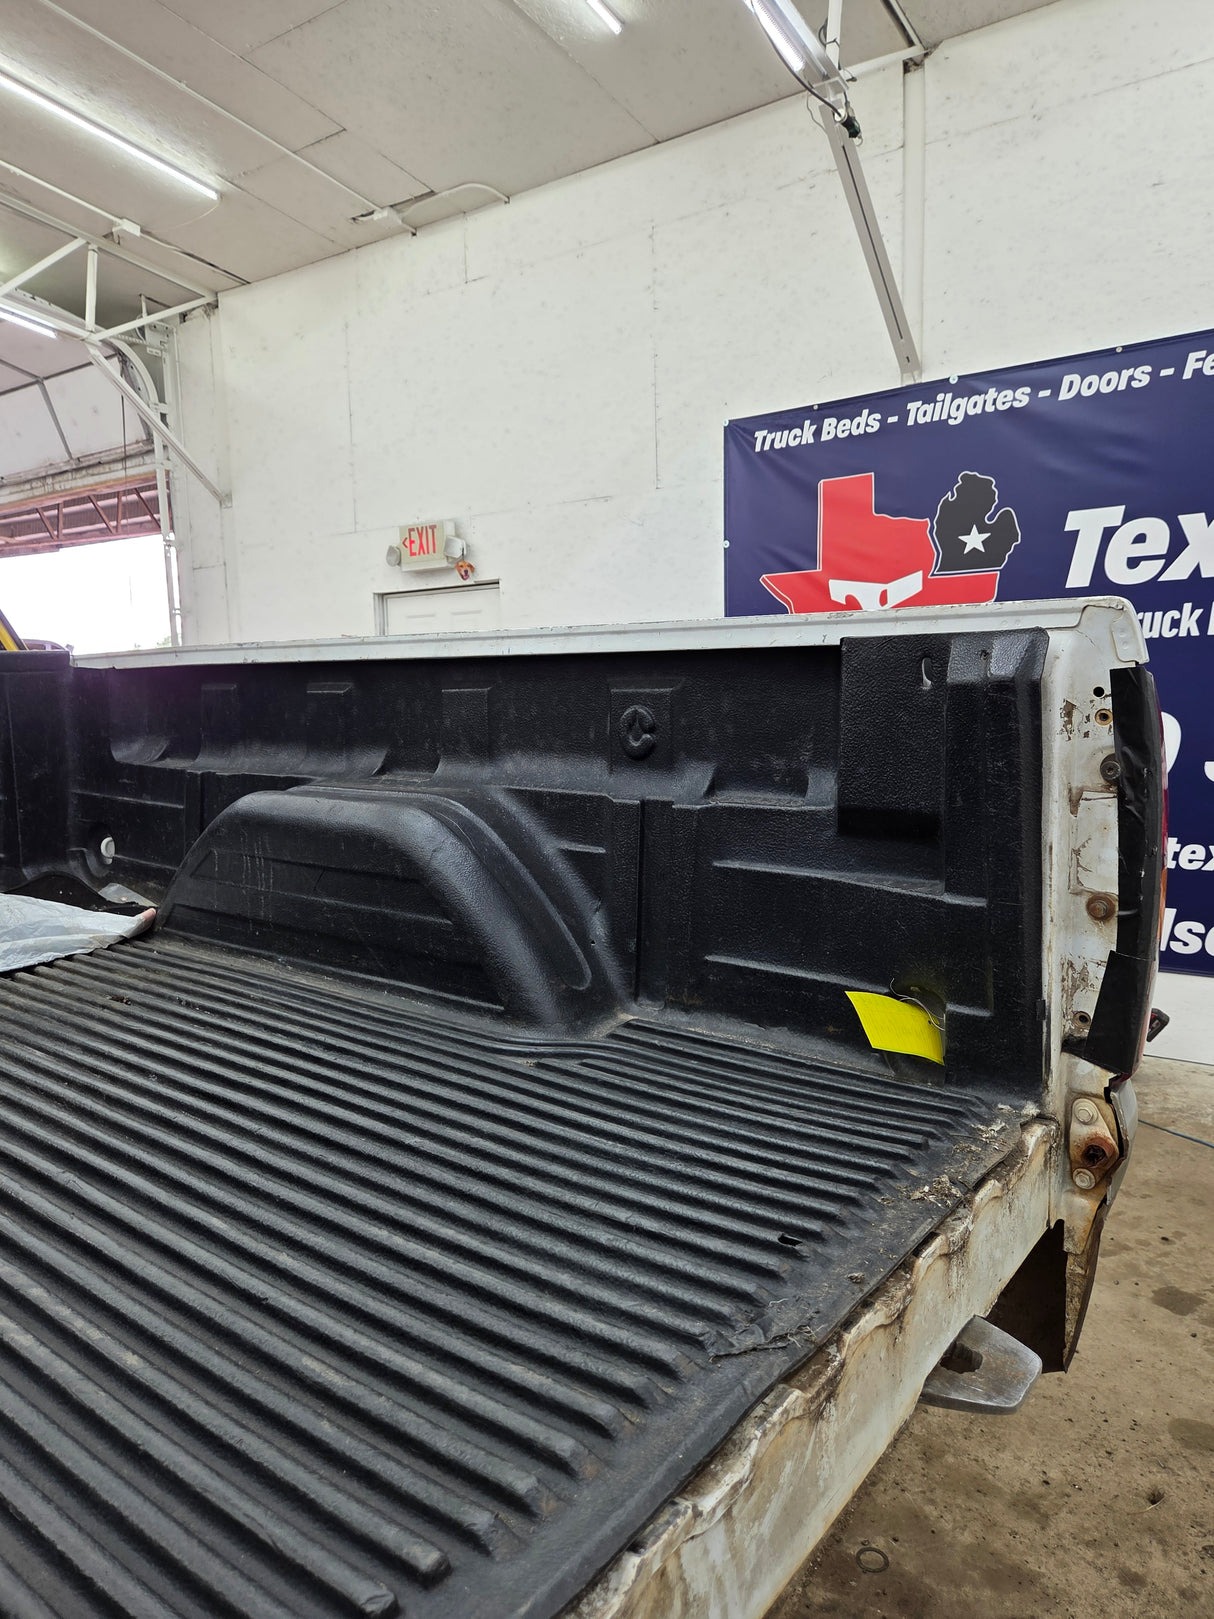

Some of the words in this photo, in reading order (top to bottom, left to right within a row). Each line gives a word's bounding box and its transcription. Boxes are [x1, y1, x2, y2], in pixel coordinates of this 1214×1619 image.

[754, 419, 817, 452] Truck
[820, 409, 882, 442] Beds
[906, 383, 1031, 425] Tailgates
[1057, 365, 1153, 401] Doors
[408, 524, 437, 557] EXIT
[1063, 504, 1214, 589] Tex
